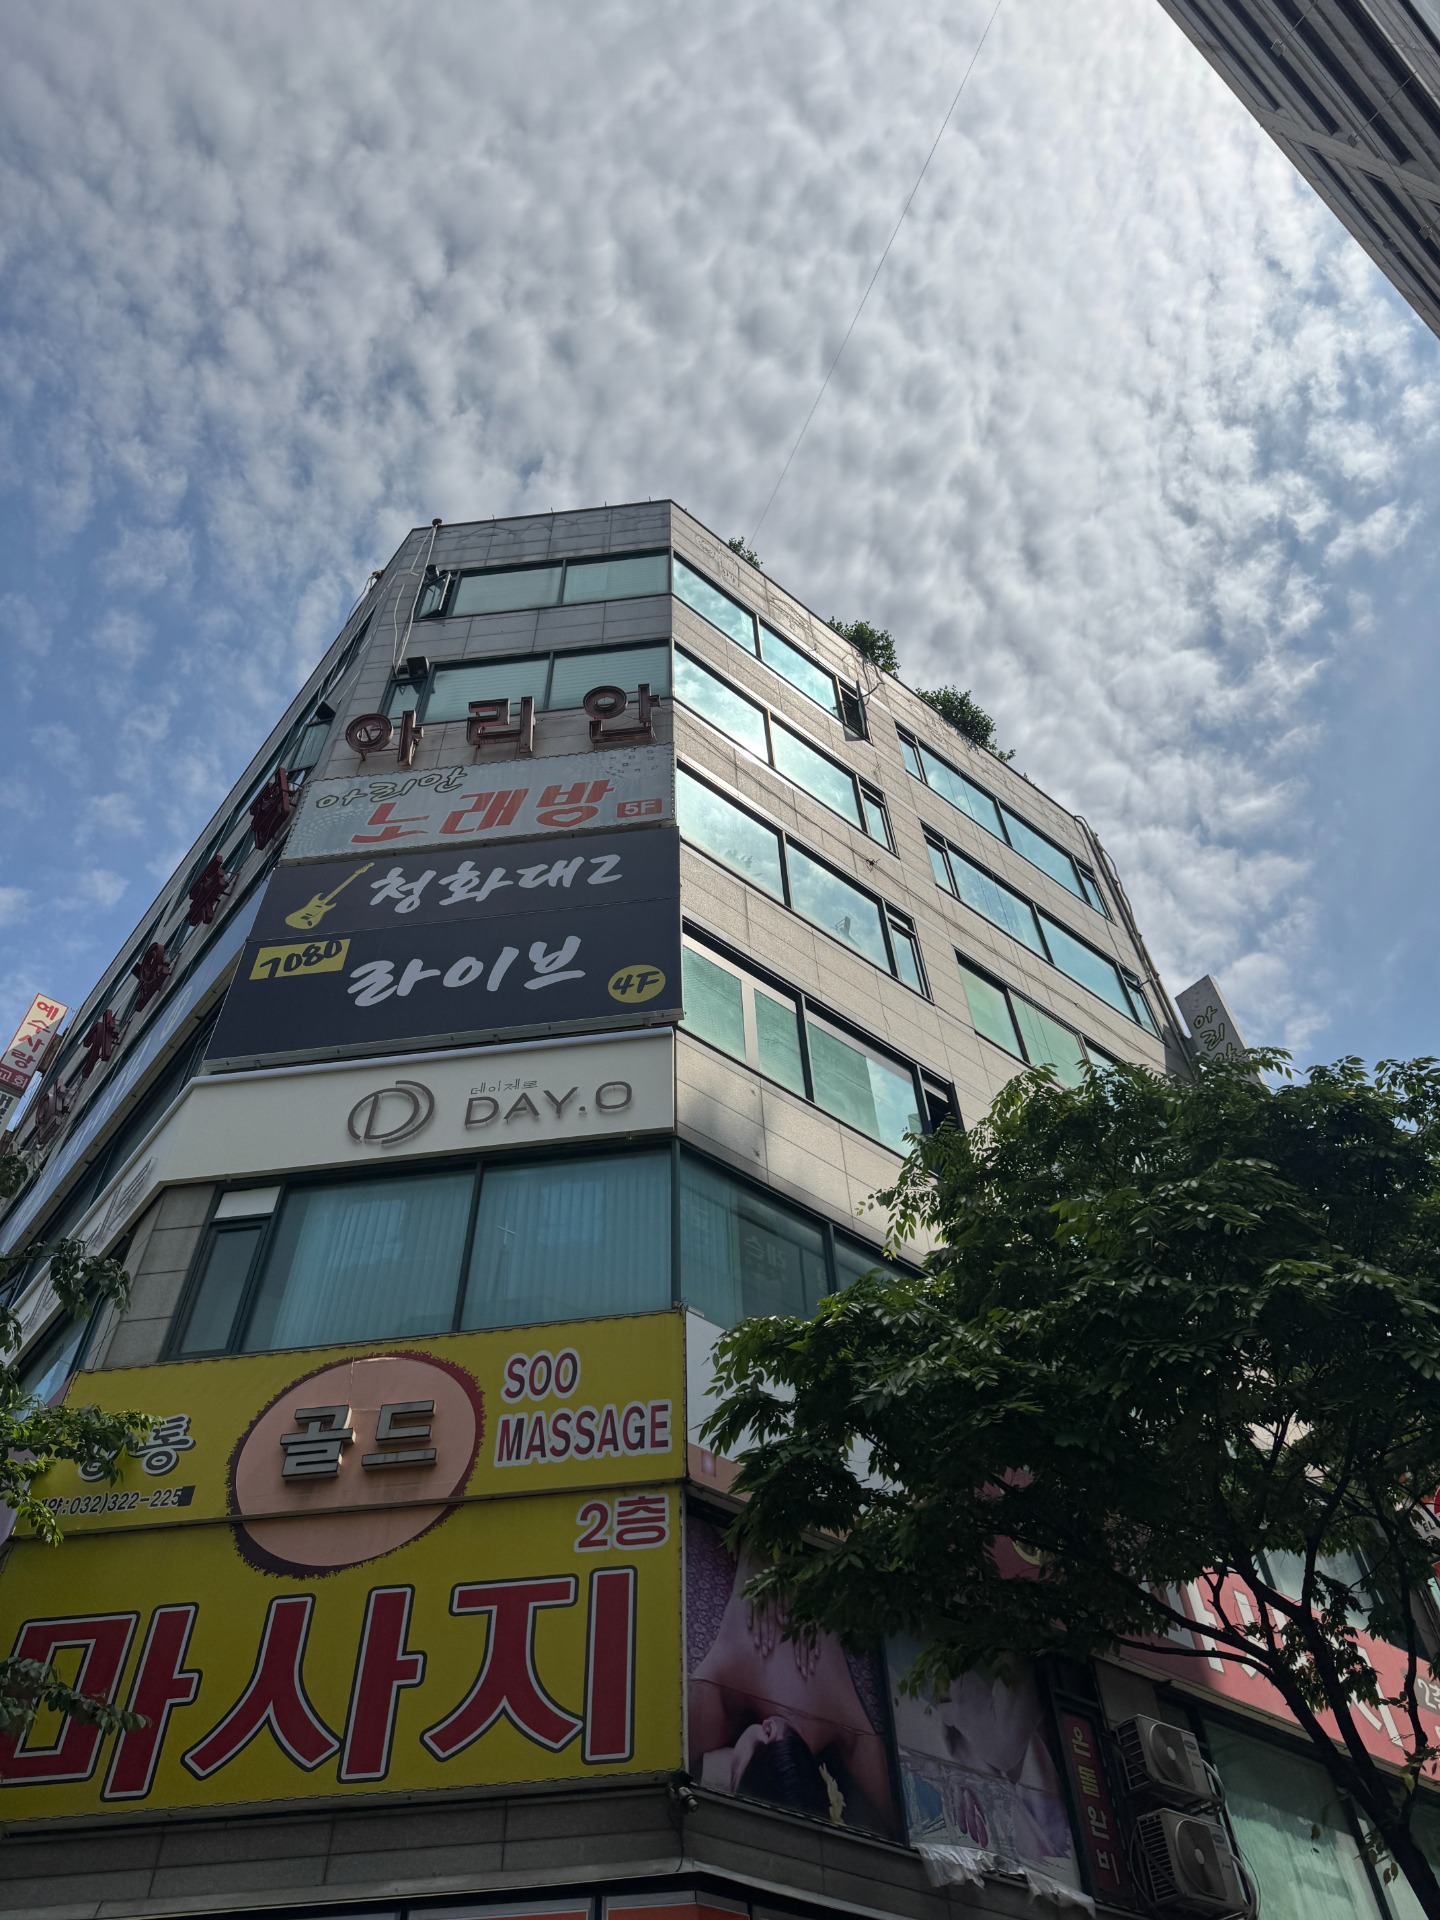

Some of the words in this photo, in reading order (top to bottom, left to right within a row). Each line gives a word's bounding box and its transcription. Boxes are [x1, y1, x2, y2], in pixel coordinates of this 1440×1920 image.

[345, 683, 661, 766] 아리안
[315, 765, 468, 809] 아리안
[350, 779, 614, 843] 노래방
[622, 801, 657, 817] 5F
[259, 939, 344, 978] 7080
[347, 935, 586, 1007] 라이브
[612, 970, 662, 996] 4F
[11, 1001, 59, 1069] 예수사랑
[470, 1079, 538, 1096] 데이제로
[502, 1350, 580, 1400] SOO
[280, 1400, 438, 1481] 골드
[497, 1403, 671, 1463] MASSAGE
[577, 1494, 668, 1549] 2층
[0, 1566, 638, 1800] 마사지
